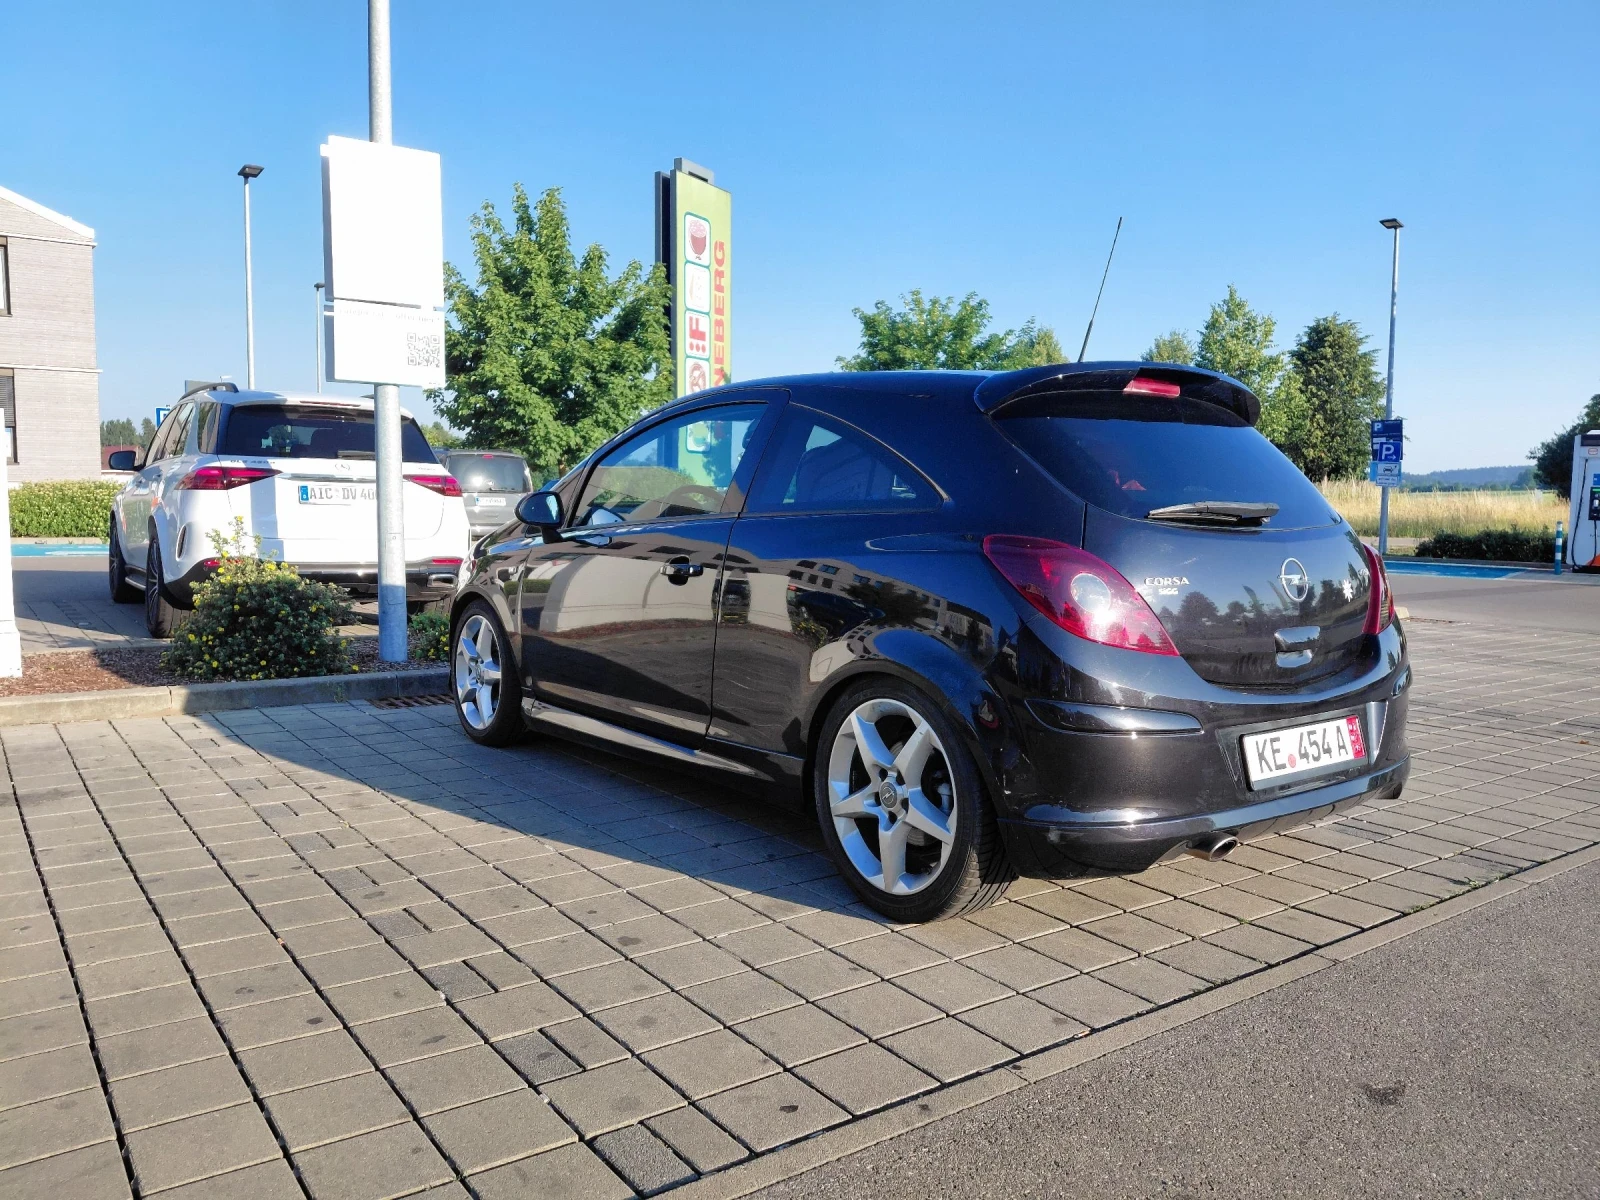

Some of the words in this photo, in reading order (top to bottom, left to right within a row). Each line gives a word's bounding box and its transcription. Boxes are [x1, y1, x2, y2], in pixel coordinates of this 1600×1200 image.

[1374, 422, 1382, 431] P
[1381, 444, 1395, 460] P
[310, 487, 333, 500] AIC
[342, 487, 357, 500] DV
[360, 488, 377, 500] 40
[1144, 576, 1190, 586] CORSA
[1255, 736, 1287, 773] KE
[1298, 727, 1333, 764] 454
[1335, 725, 1349, 756] A
